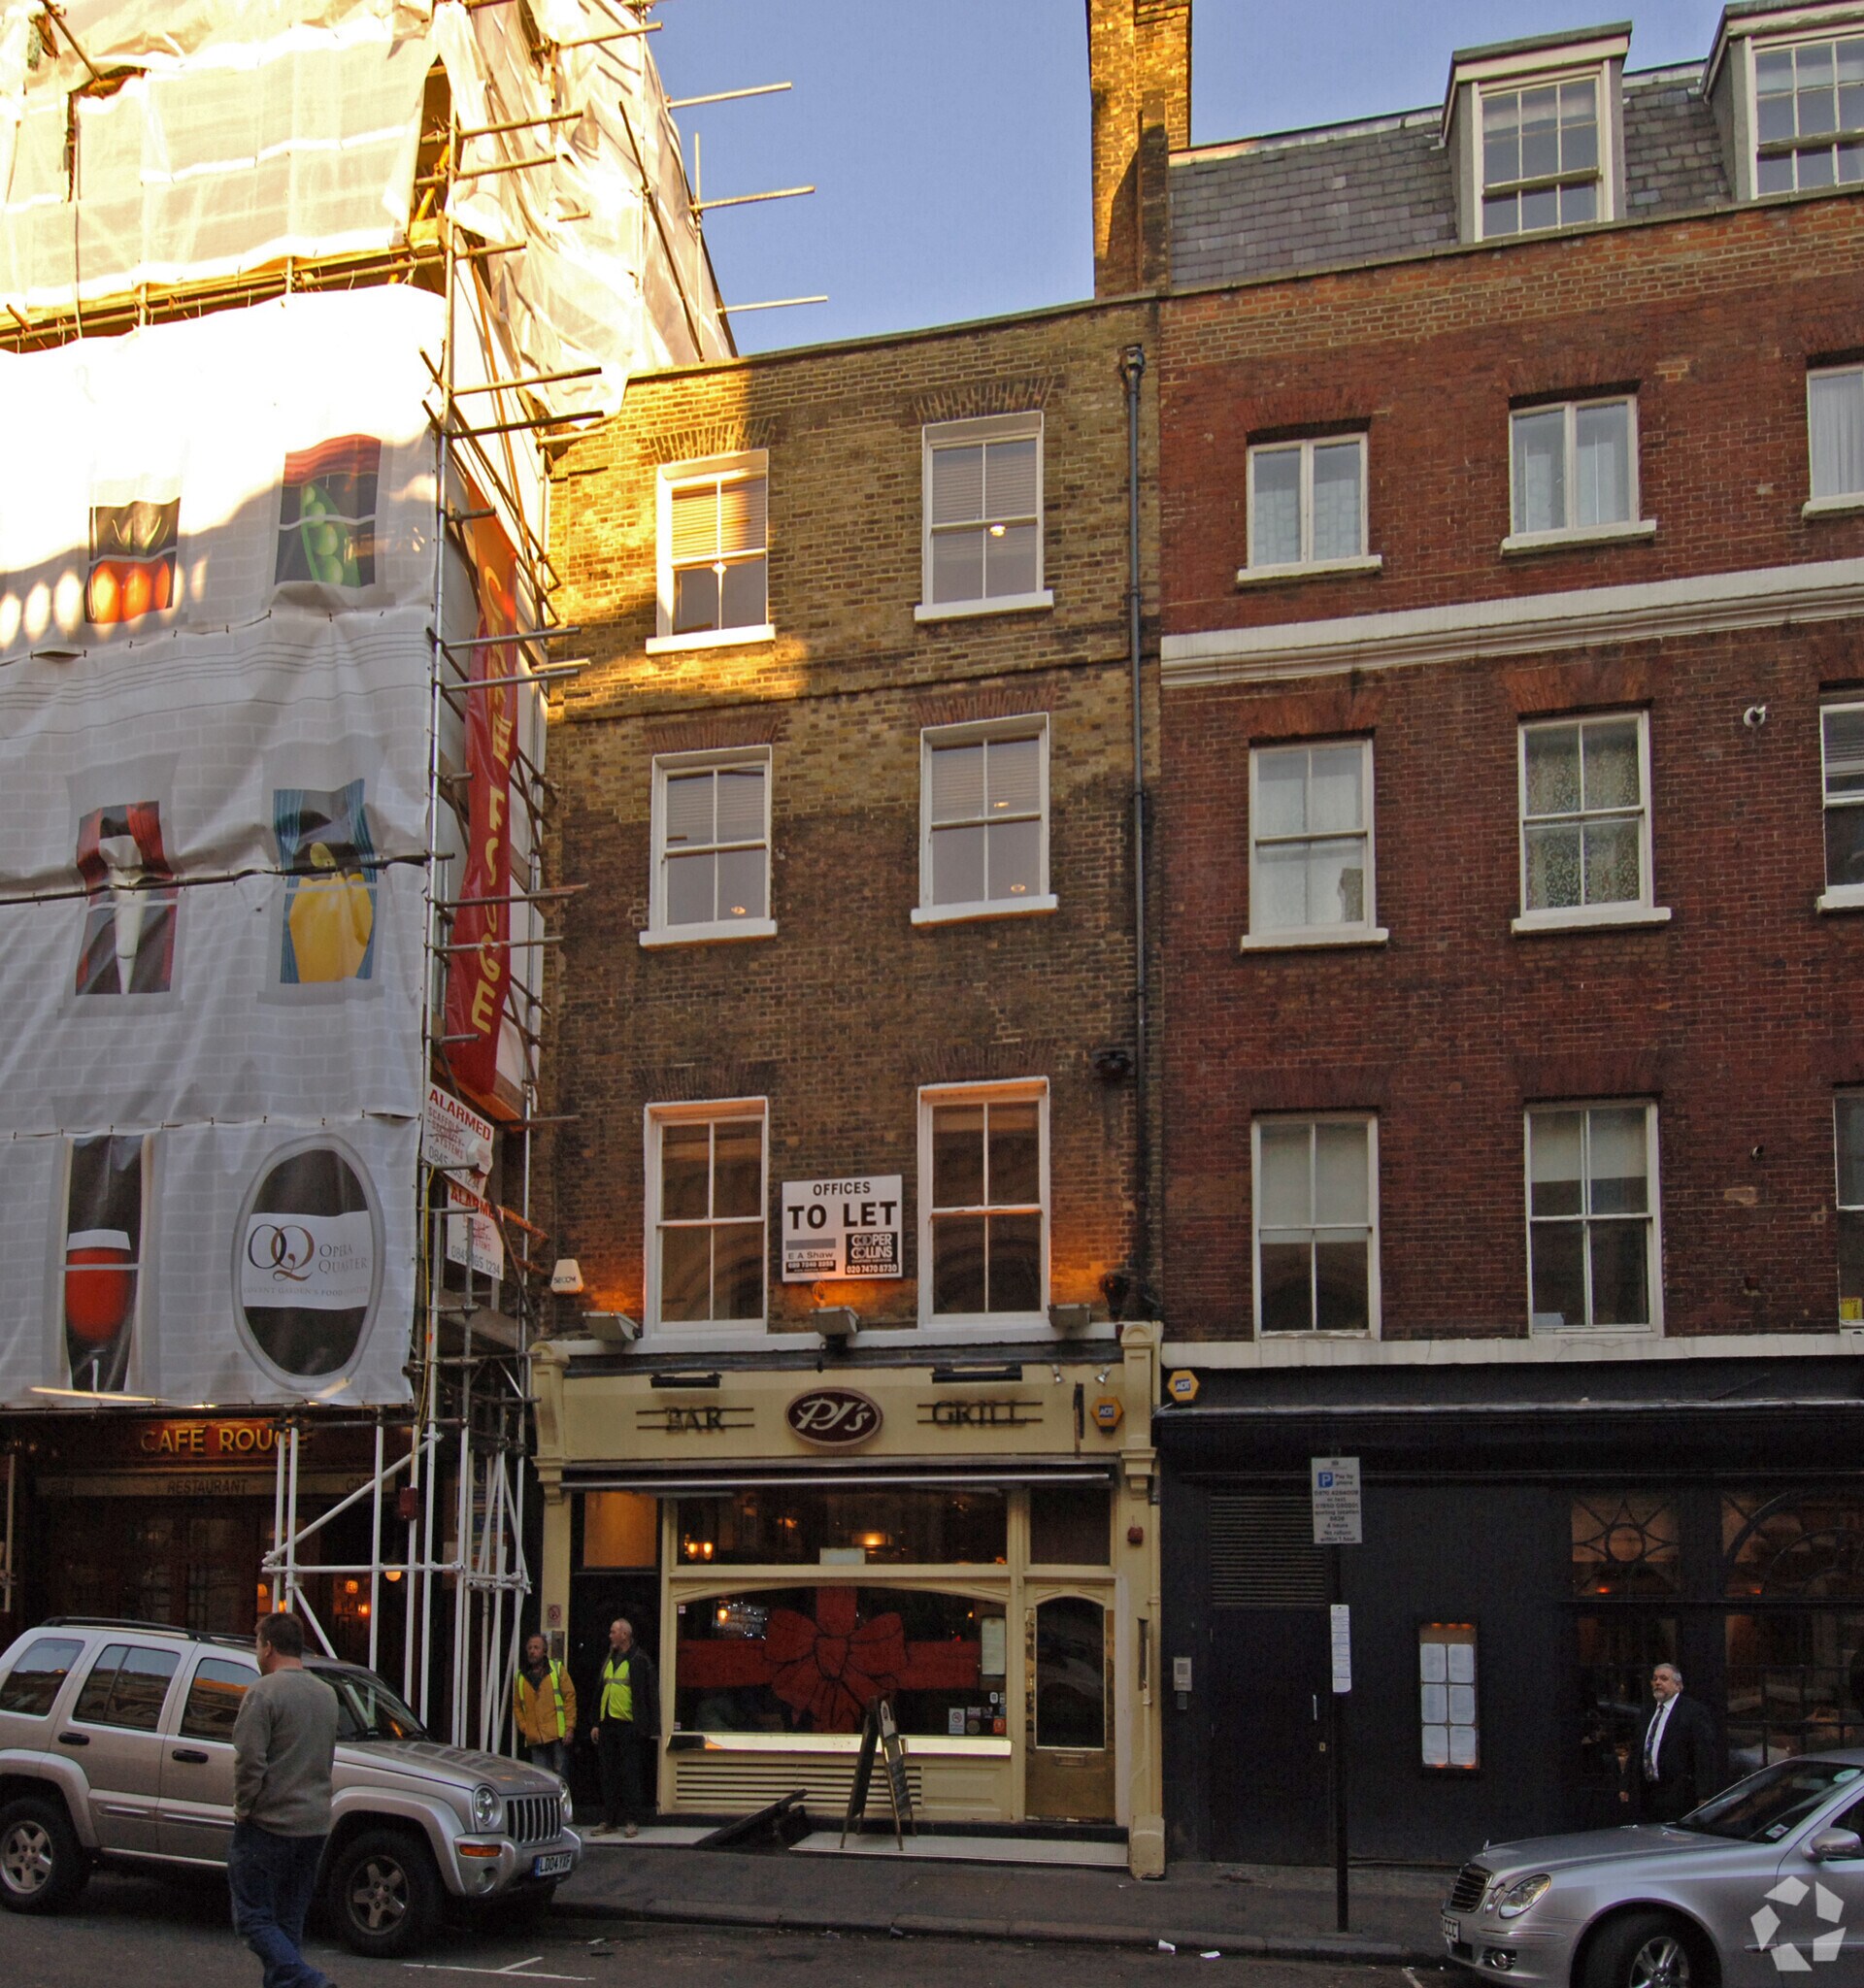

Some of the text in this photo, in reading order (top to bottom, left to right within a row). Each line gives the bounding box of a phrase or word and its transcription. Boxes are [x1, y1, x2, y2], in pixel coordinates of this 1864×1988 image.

[428, 1088, 491, 1143] ALARMED
[813, 1180, 871, 1197] OFFICES
[787, 1200, 897, 1231] TO LET
[850, 1233, 893, 1248] COOPER
[788, 1251, 795, 1260] E
[807, 1249, 834, 1261] Shaw
[850, 1246, 893, 1261] COLLINS
[847, 1264, 862, 1275] 020
[861, 1263, 878, 1274] 7470
[320, 1287, 344, 1298] FOOD
[1175, 1380, 1191, 1391] ADT
[664, 1406, 723, 1432] BAR
[932, 1400, 1027, 1426] GRILL
[1099, 1408, 1114, 1416] ADT
[166, 1477, 249, 1496] RESTAURANT
[1321, 1473, 1332, 1487] P
